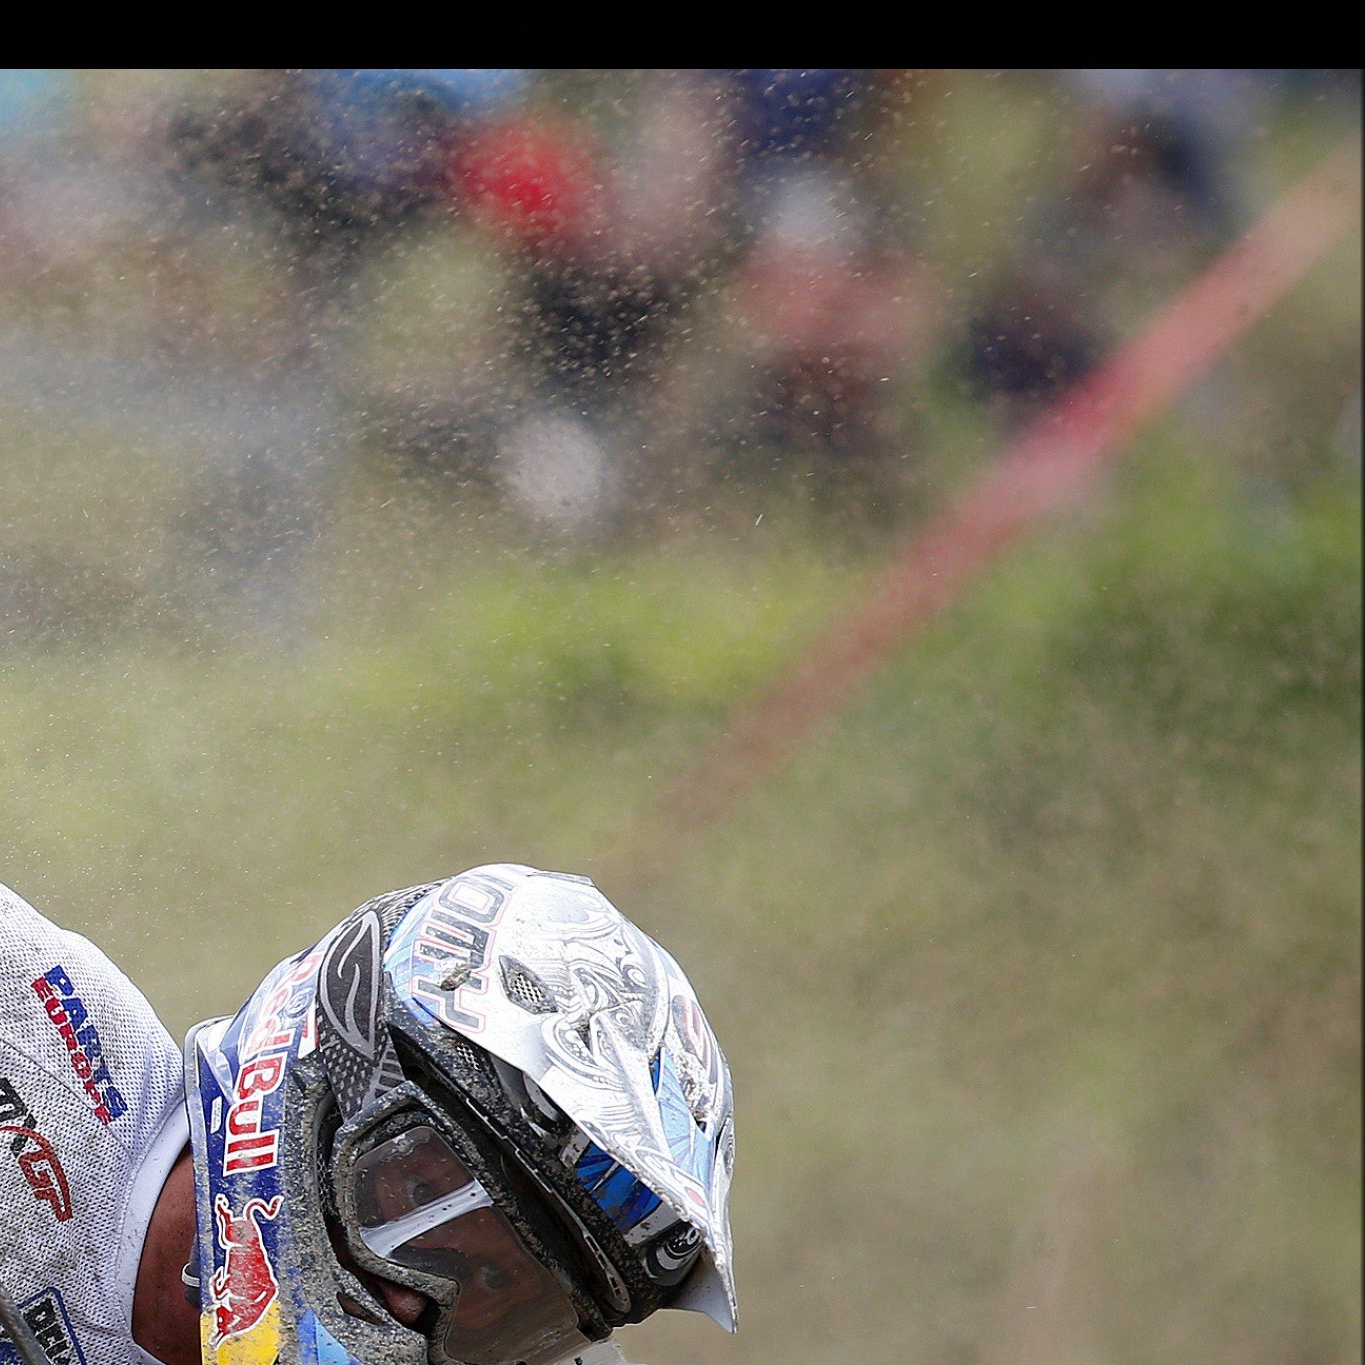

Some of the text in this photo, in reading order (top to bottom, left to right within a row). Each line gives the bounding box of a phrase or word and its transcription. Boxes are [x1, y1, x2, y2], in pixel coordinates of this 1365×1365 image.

[30, 976, 112, 1125] EUROPE
[44, 965, 128, 1122] PARTS
[223, 1053, 289, 1177] Bull
